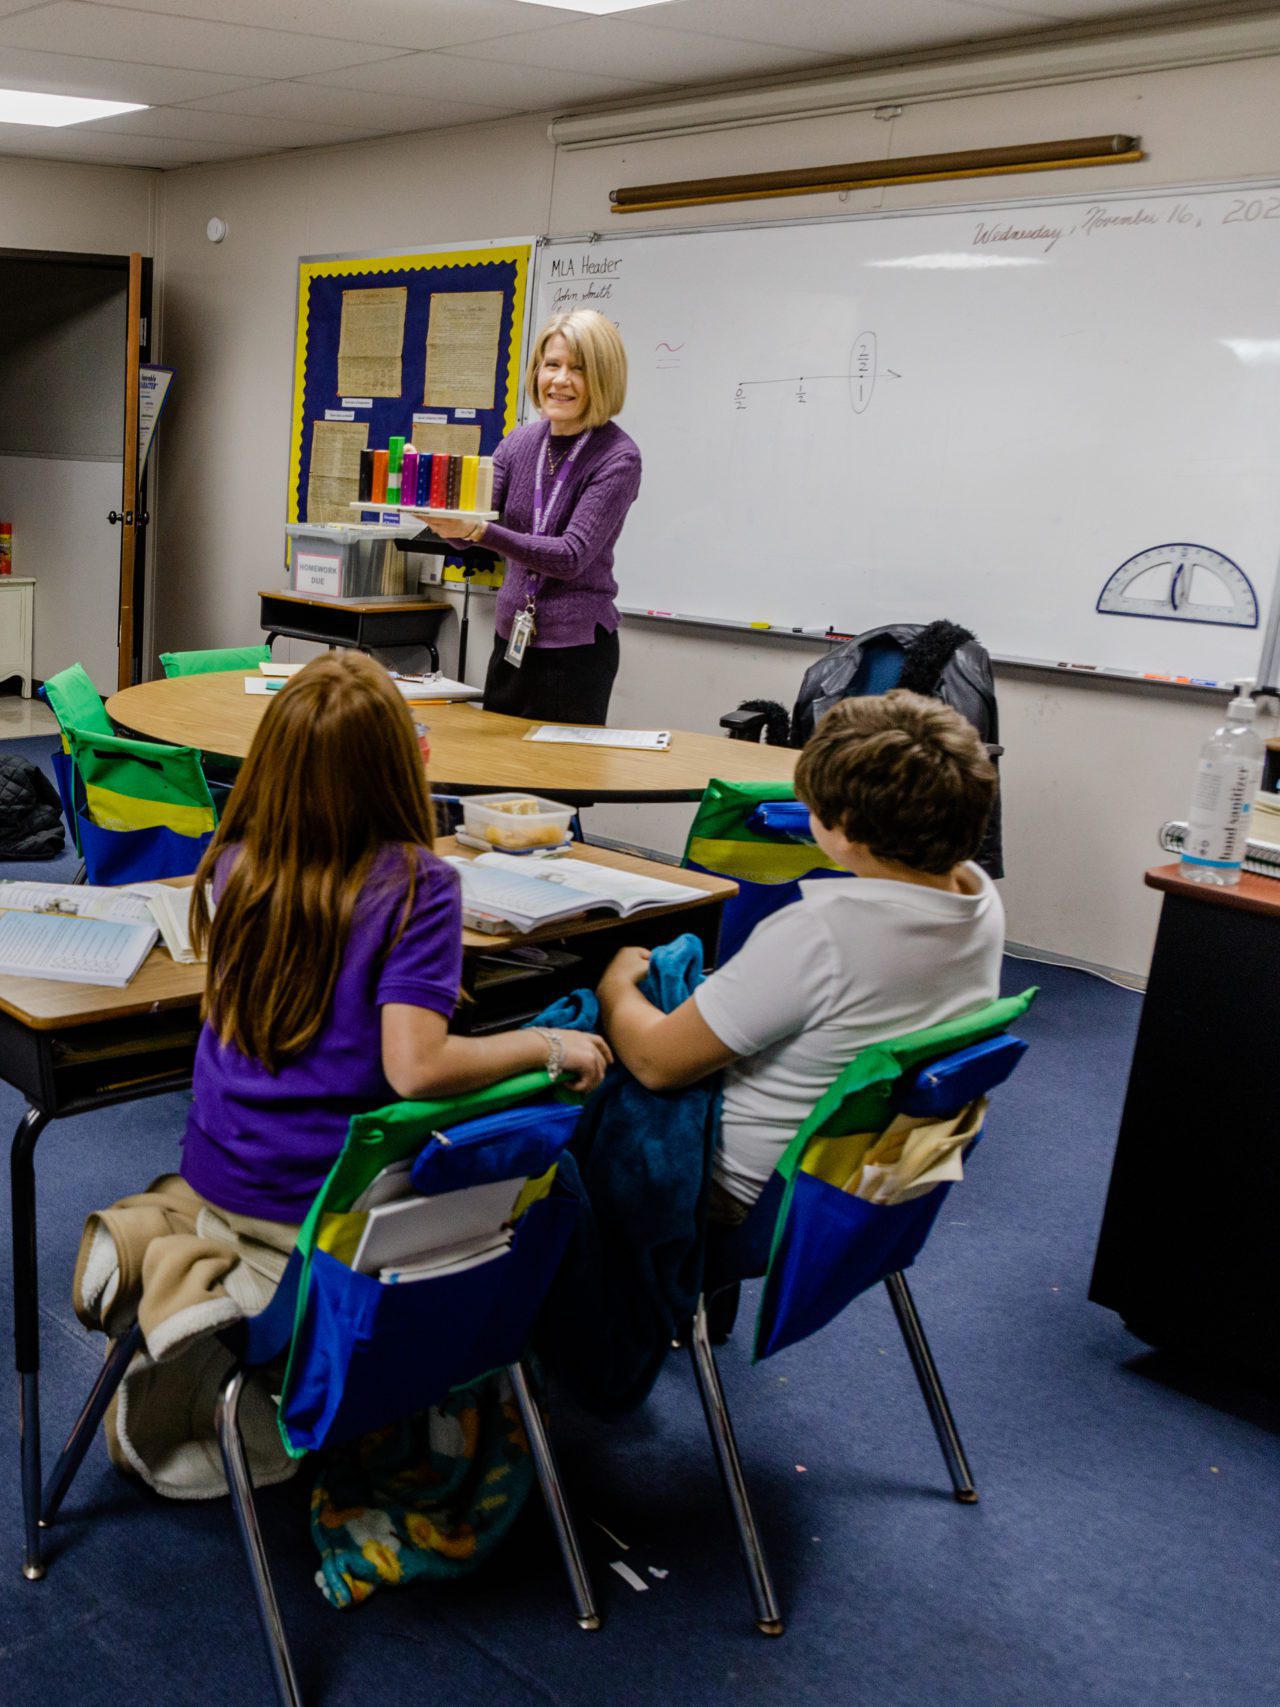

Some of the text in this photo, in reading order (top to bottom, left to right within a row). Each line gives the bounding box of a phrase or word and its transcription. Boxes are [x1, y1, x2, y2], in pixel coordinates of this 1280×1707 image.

[551, 254, 623, 277] MLA Header
[299, 563, 338, 574] HOMEWORK
[311, 576, 325, 585] DUE
[1218, 827, 1237, 860] hand
[1229, 767, 1249, 824] sanitizer
